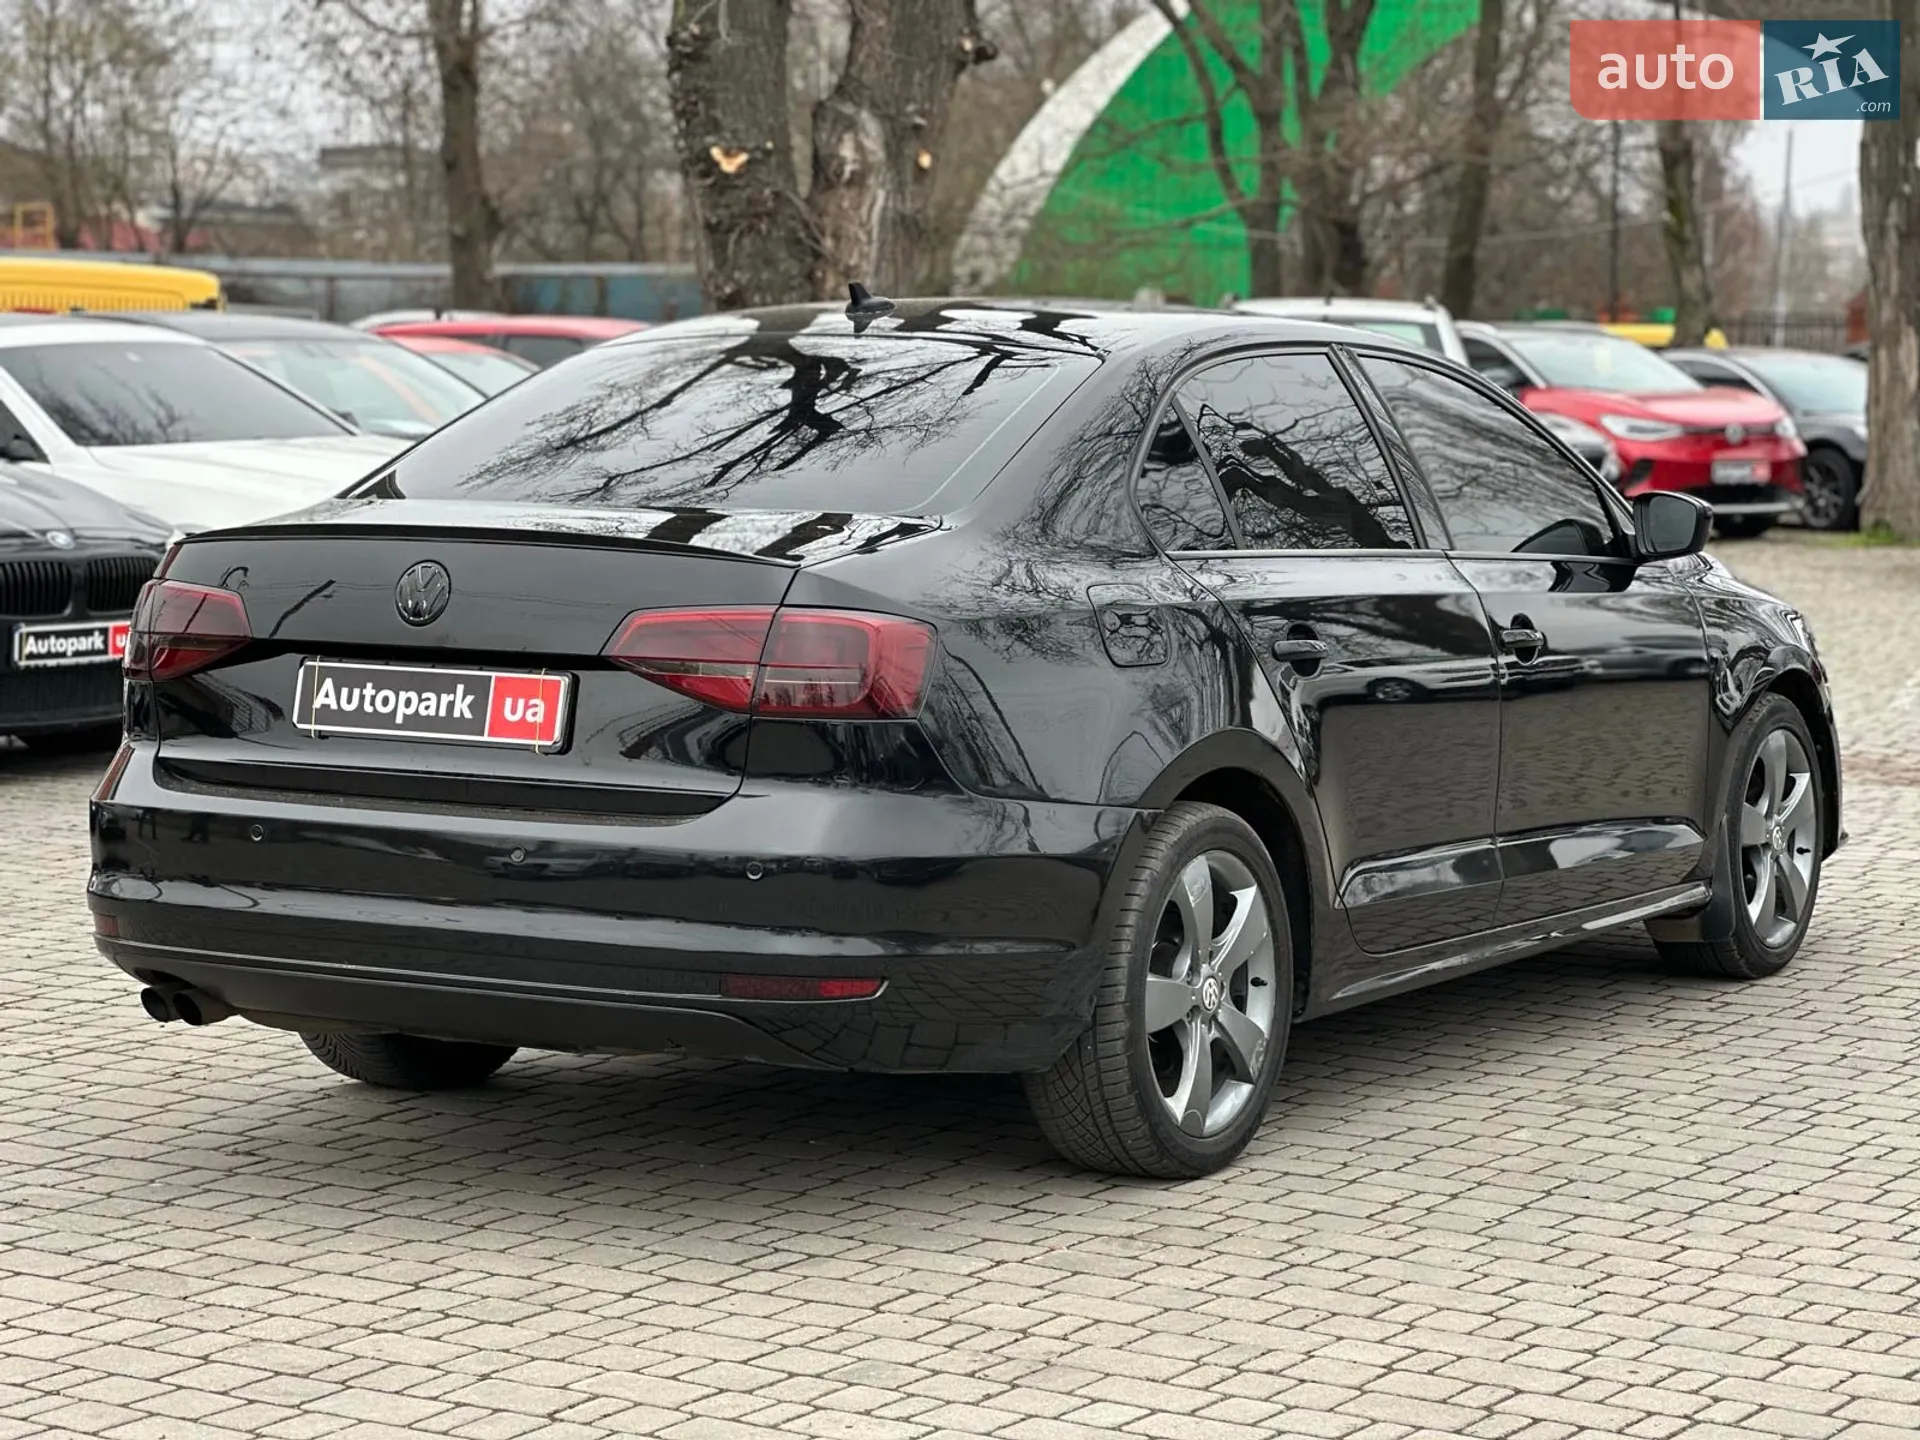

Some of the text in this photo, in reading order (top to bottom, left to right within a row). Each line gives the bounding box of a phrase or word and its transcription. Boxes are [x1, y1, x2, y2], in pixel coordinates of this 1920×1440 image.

[24, 630, 127, 657] Autopark u
[313, 677, 545, 724] Autopark ua
